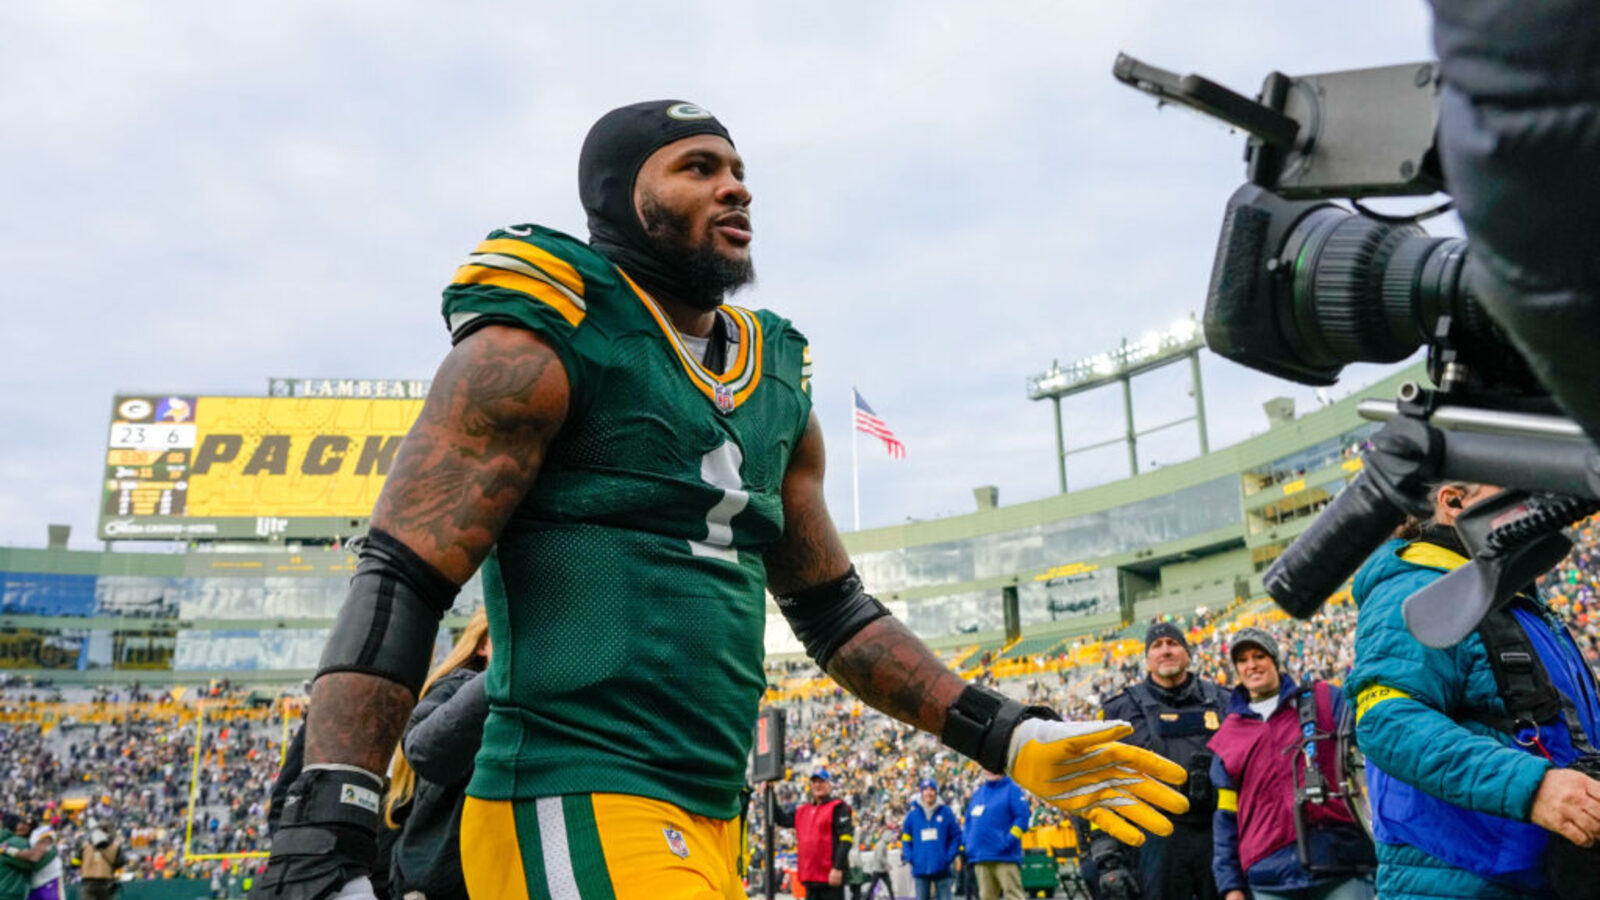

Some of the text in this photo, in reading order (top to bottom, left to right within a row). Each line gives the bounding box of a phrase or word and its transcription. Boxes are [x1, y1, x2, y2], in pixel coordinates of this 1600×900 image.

[303, 379, 424, 397] LAMBEAU
[120, 426, 146, 444] 23
[166, 428, 180, 444] 6
[687, 439, 750, 564] 1
